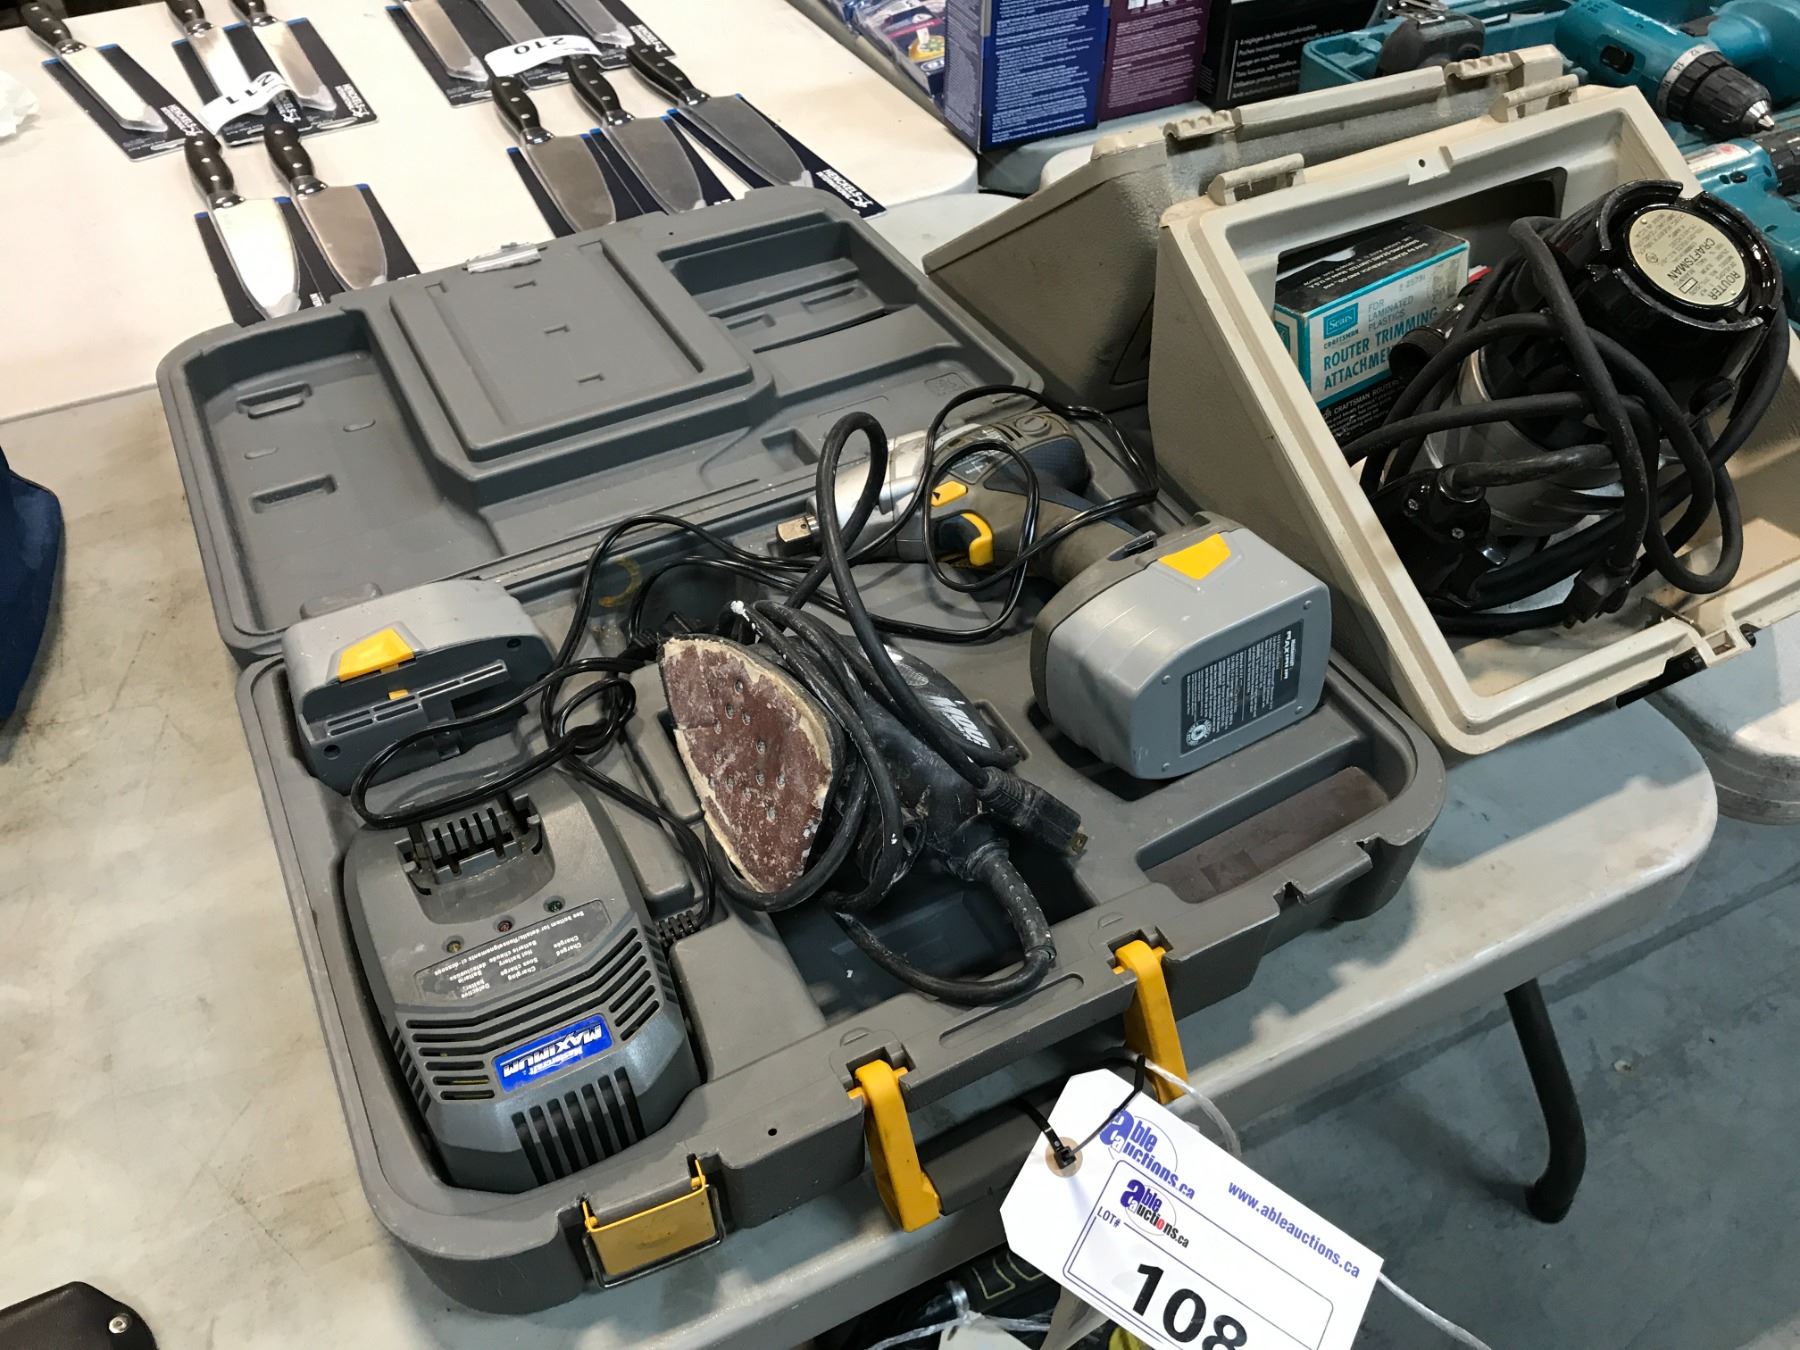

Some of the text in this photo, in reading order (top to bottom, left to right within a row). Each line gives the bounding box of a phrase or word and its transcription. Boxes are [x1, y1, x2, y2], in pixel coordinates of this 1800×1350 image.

[513, 37, 567, 55] 210
[822, 169, 863, 199] HENCKELS
[1666, 237, 1716, 281] CRAFTSMAN
[1708, 270, 1741, 300] ROUTER
[1368, 299, 1385, 312] FOR
[1368, 296, 1414, 323] LAMINATED
[1328, 313, 1353, 330] Sears
[1368, 311, 1407, 332] PLASTICS
[1323, 329, 1359, 350] CRAFTSMAN
[1323, 337, 1370, 372] ROUTER
[1375, 307, 1438, 346] TRIMMING
[1324, 347, 1392, 390] ATTACHME
[551, 915, 572, 928] bottom
[573, 910, 584, 918] See
[541, 925, 550, 933] for
[489, 940, 537, 963] Batterie chaude
[499, 949, 533, 966] Hot battery
[555, 942, 582, 957] Charged
[458, 970, 483, 984] Batterie
[500, 963, 522, 976] charge
[507, 966, 537, 981] Charging
[503, 1024, 602, 1078] MAXIMUM
[1100, 1109, 1158, 1153] able
[1110, 1130, 1196, 1200] auctions.ca
[1120, 1179, 1163, 1212] able
[1096, 1206, 1122, 1228] LOT#
[1127, 1195, 1190, 1248] auctions.ca
[1227, 1182, 1360, 1278] www.ableauctions.ca
[1132, 1263, 1248, 1350] 108
